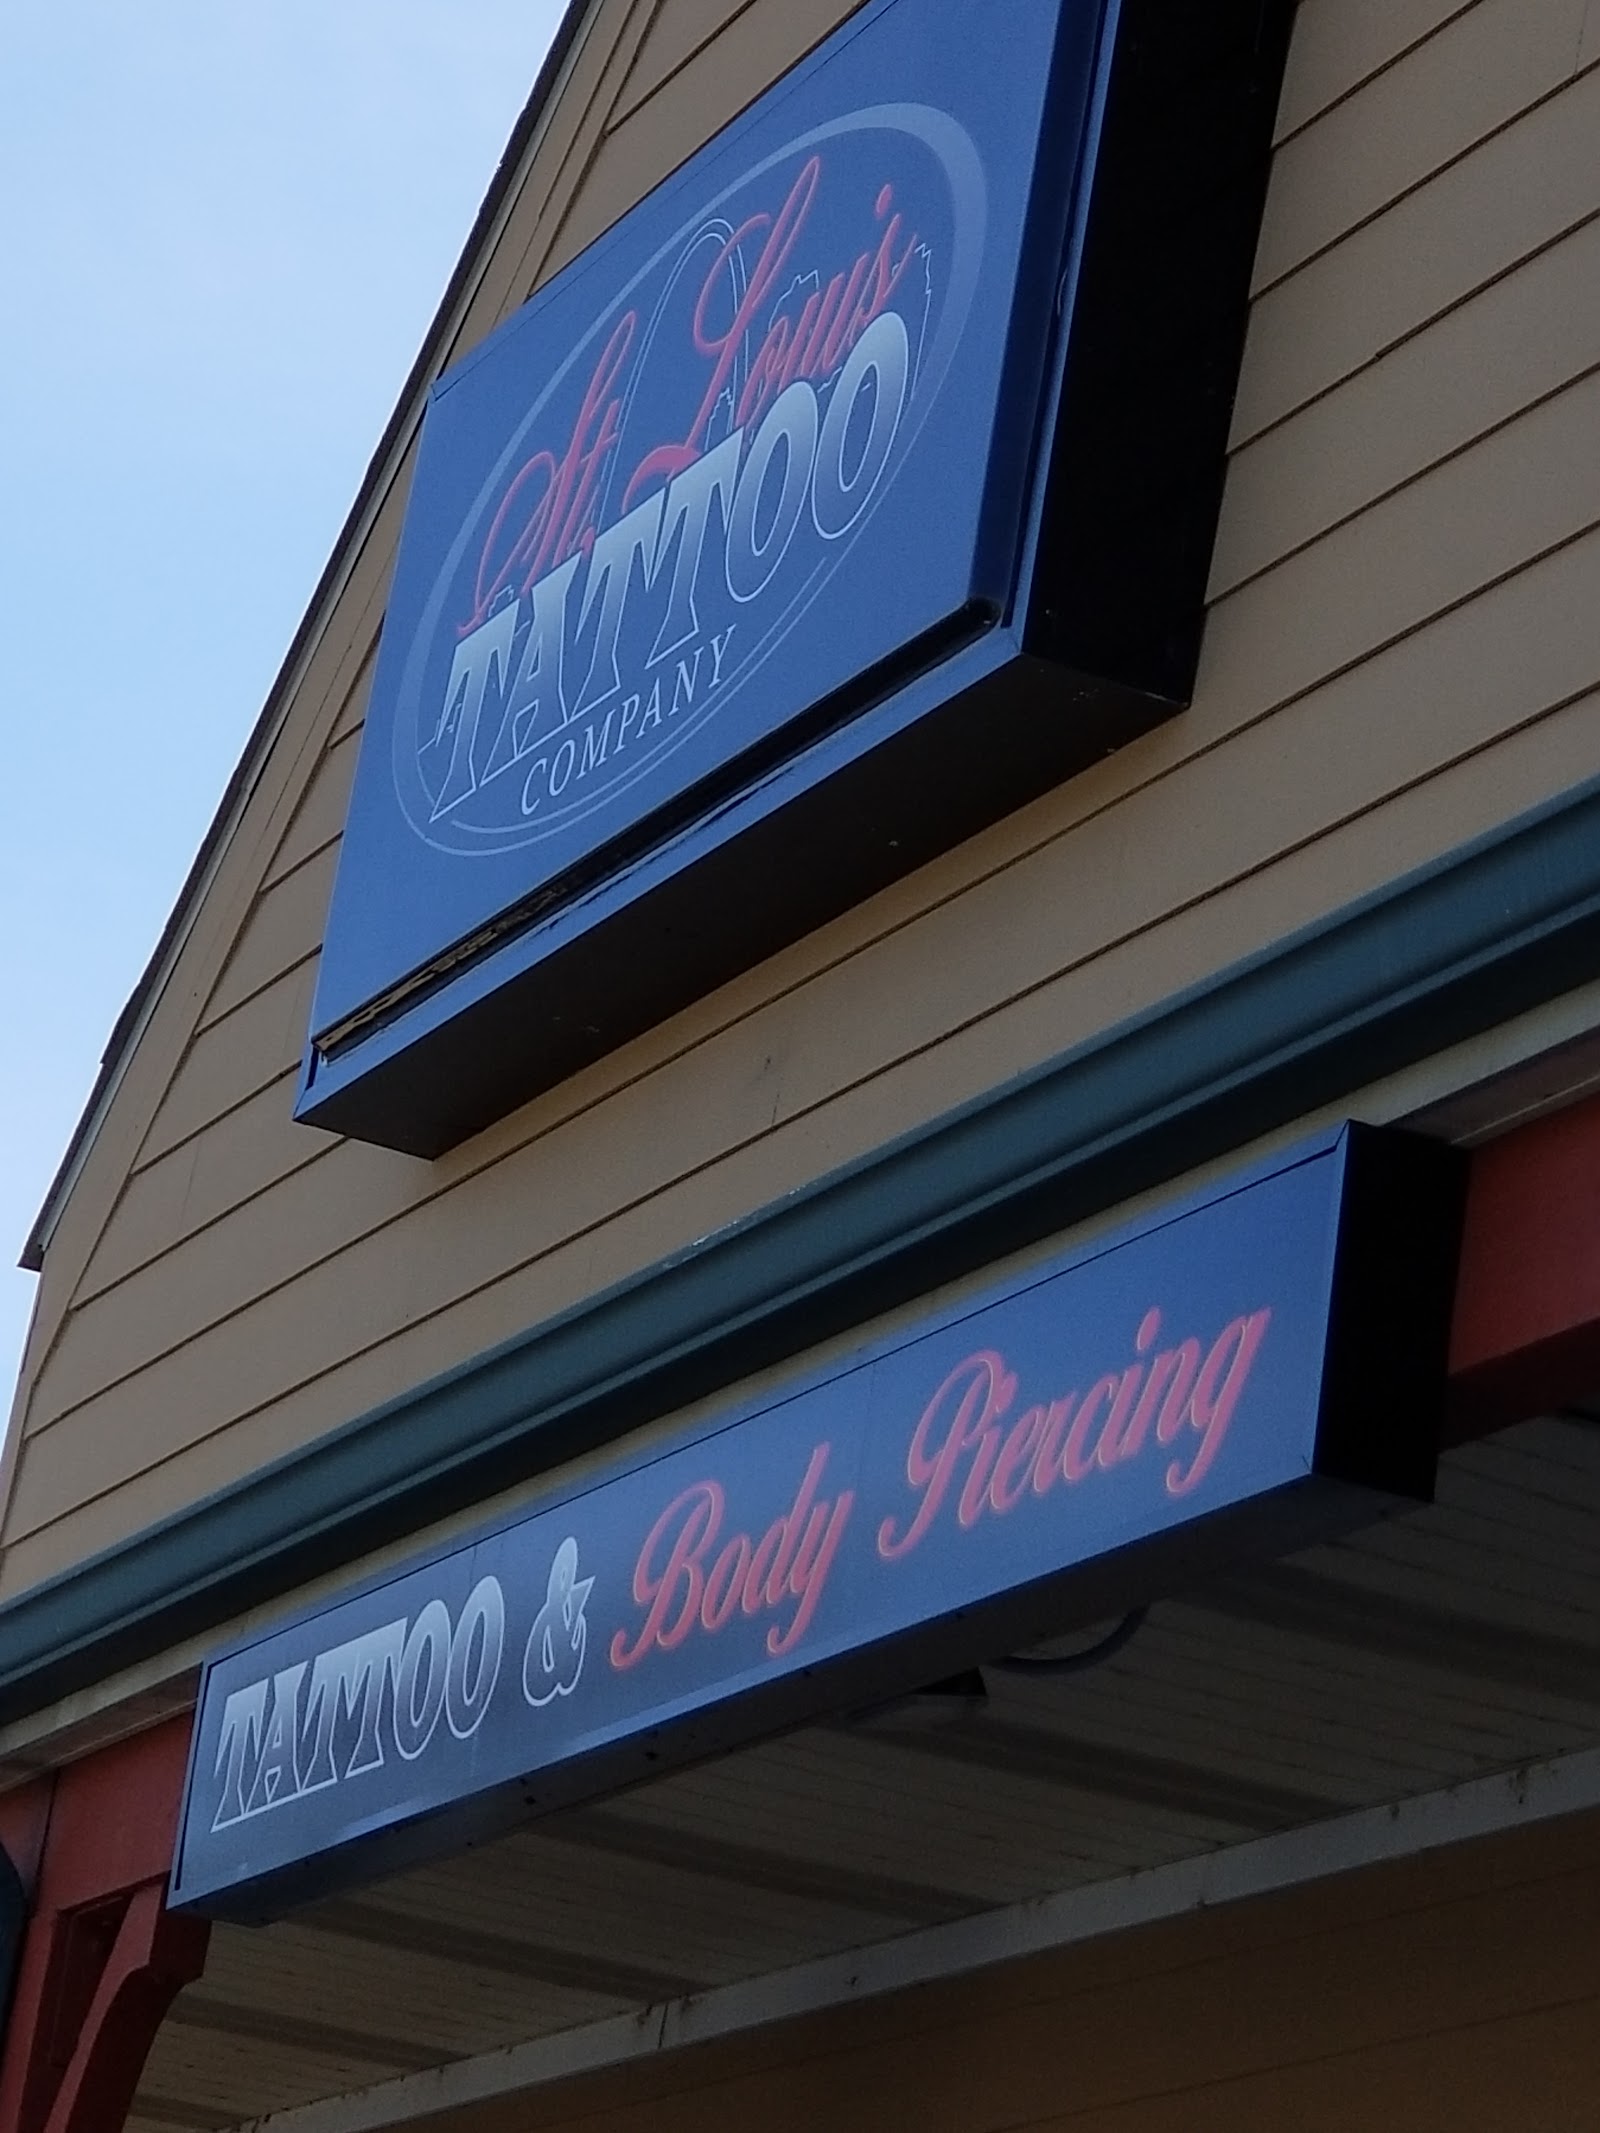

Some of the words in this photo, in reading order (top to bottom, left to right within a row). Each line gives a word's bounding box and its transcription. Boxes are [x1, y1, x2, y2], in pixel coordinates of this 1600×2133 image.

[621, 155, 918, 516] Louis
[428, 311, 909, 824] TATTOO
[521, 623, 737, 815] COMPANY
[210, 1575, 505, 1833] TATTOO
[522, 1536, 596, 1707] &
[609, 1442, 854, 1671] Body
[876, 1305, 1272, 1558] Piercing
